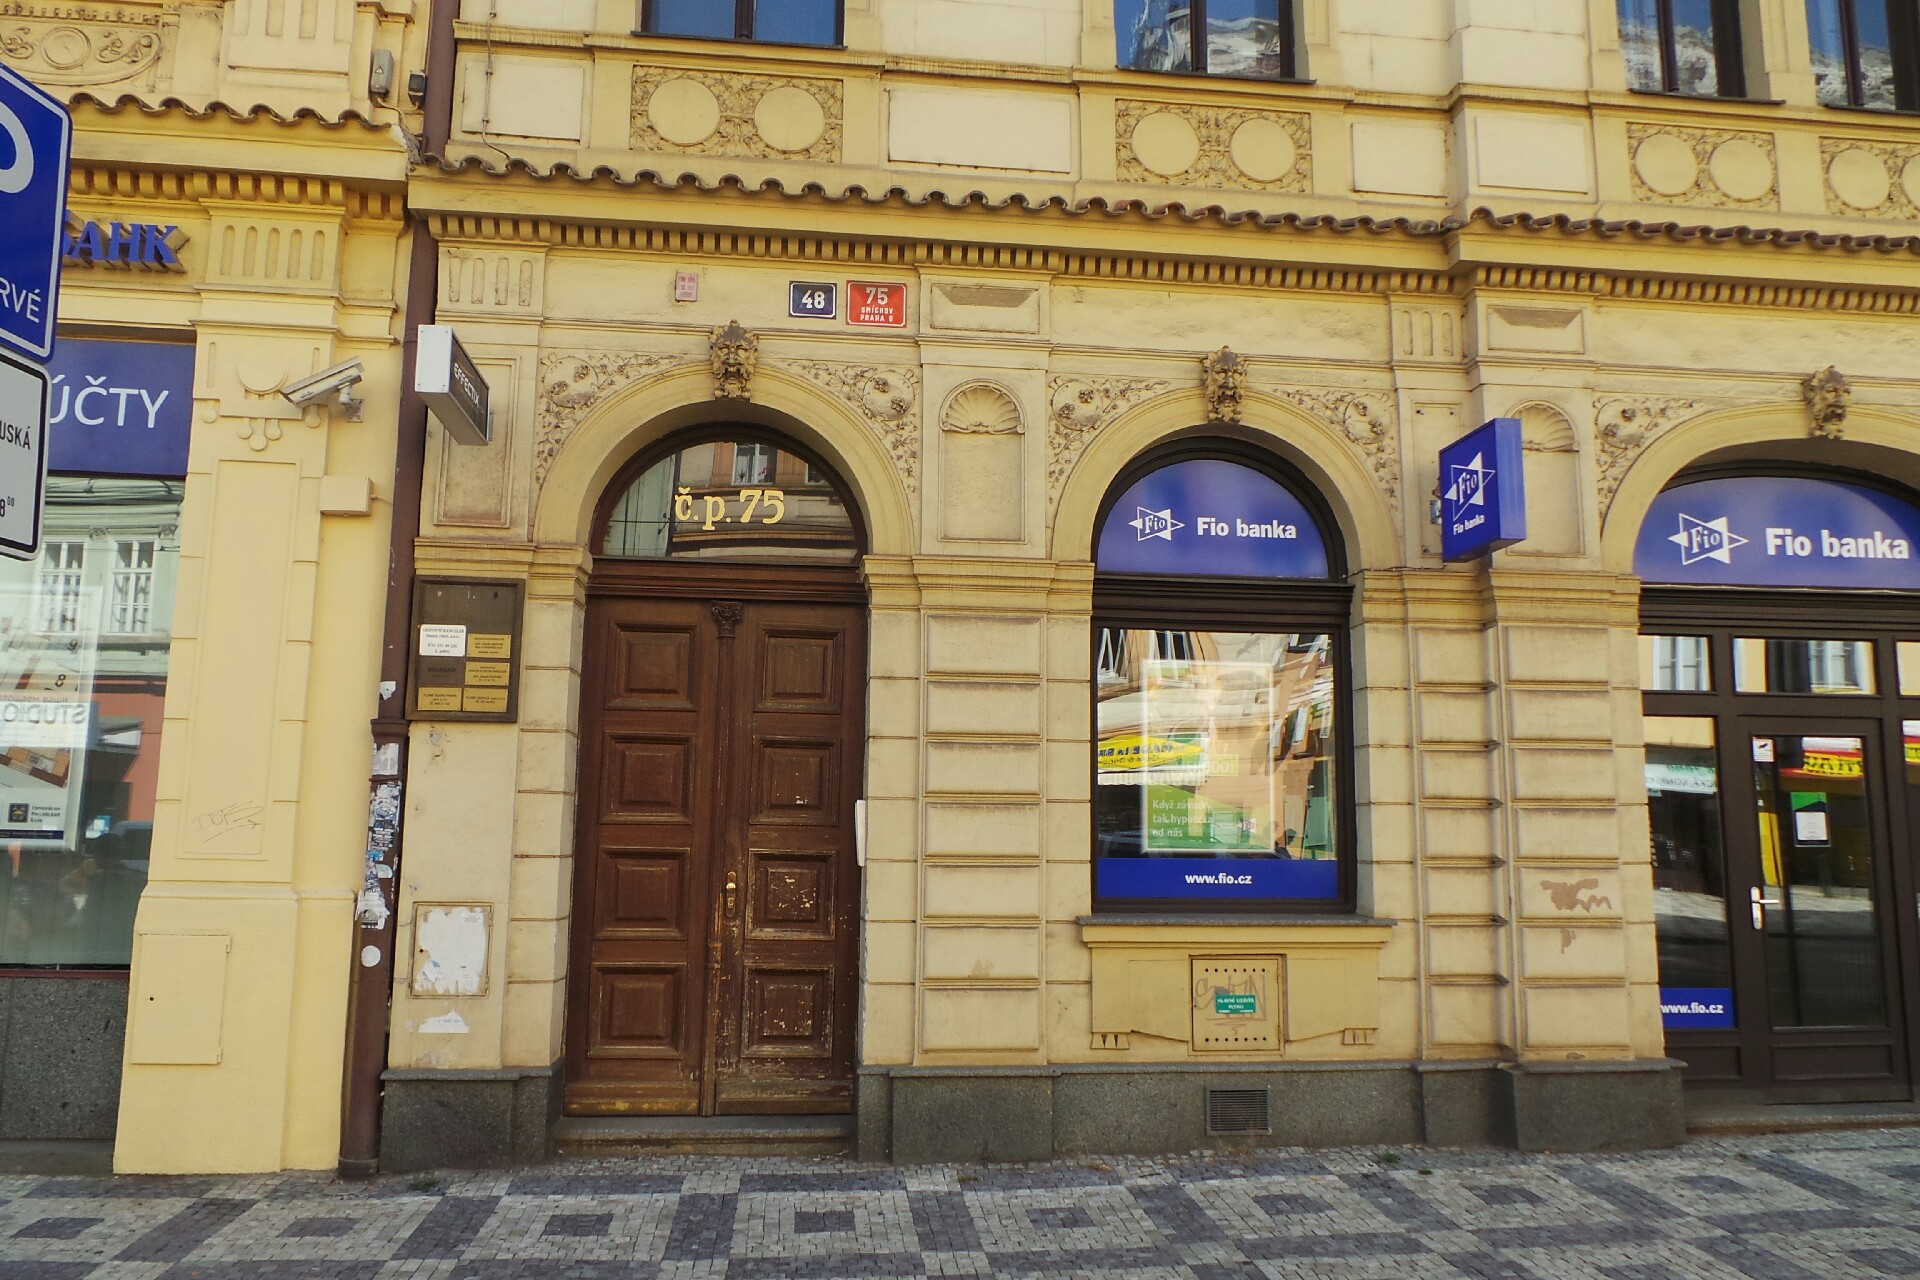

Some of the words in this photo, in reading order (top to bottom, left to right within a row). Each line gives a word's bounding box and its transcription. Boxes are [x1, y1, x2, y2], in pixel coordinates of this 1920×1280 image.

[801, 290, 825, 309] 48
[865, 287, 889, 305] 75
[860, 314, 885, 322] PRAHA
[861, 305, 894, 315] SMÍCHOV
[453, 362, 480, 408] EFFECTIX
[50, 374, 170, 428] ÚČTY
[1457, 471, 1478, 506] Fio
[1144, 514, 1166, 534] Fio
[1197, 517, 1230, 536] Fio
[1236, 518, 1297, 539] banka
[1452, 523, 1464, 536] Fio
[1464, 514, 1485, 531] banka
[1690, 526, 1721, 554] Fio
[1765, 527, 1812, 557] Fio
[1820, 529, 1909, 559] banka
[1152, 800, 1174, 810] Když
[1152, 828, 1164, 837] od
[1167, 828, 1183, 837] nás
[1184, 872, 1252, 884] www.fio.cz
[1660, 1002, 1724, 1014] www.fio.cz
